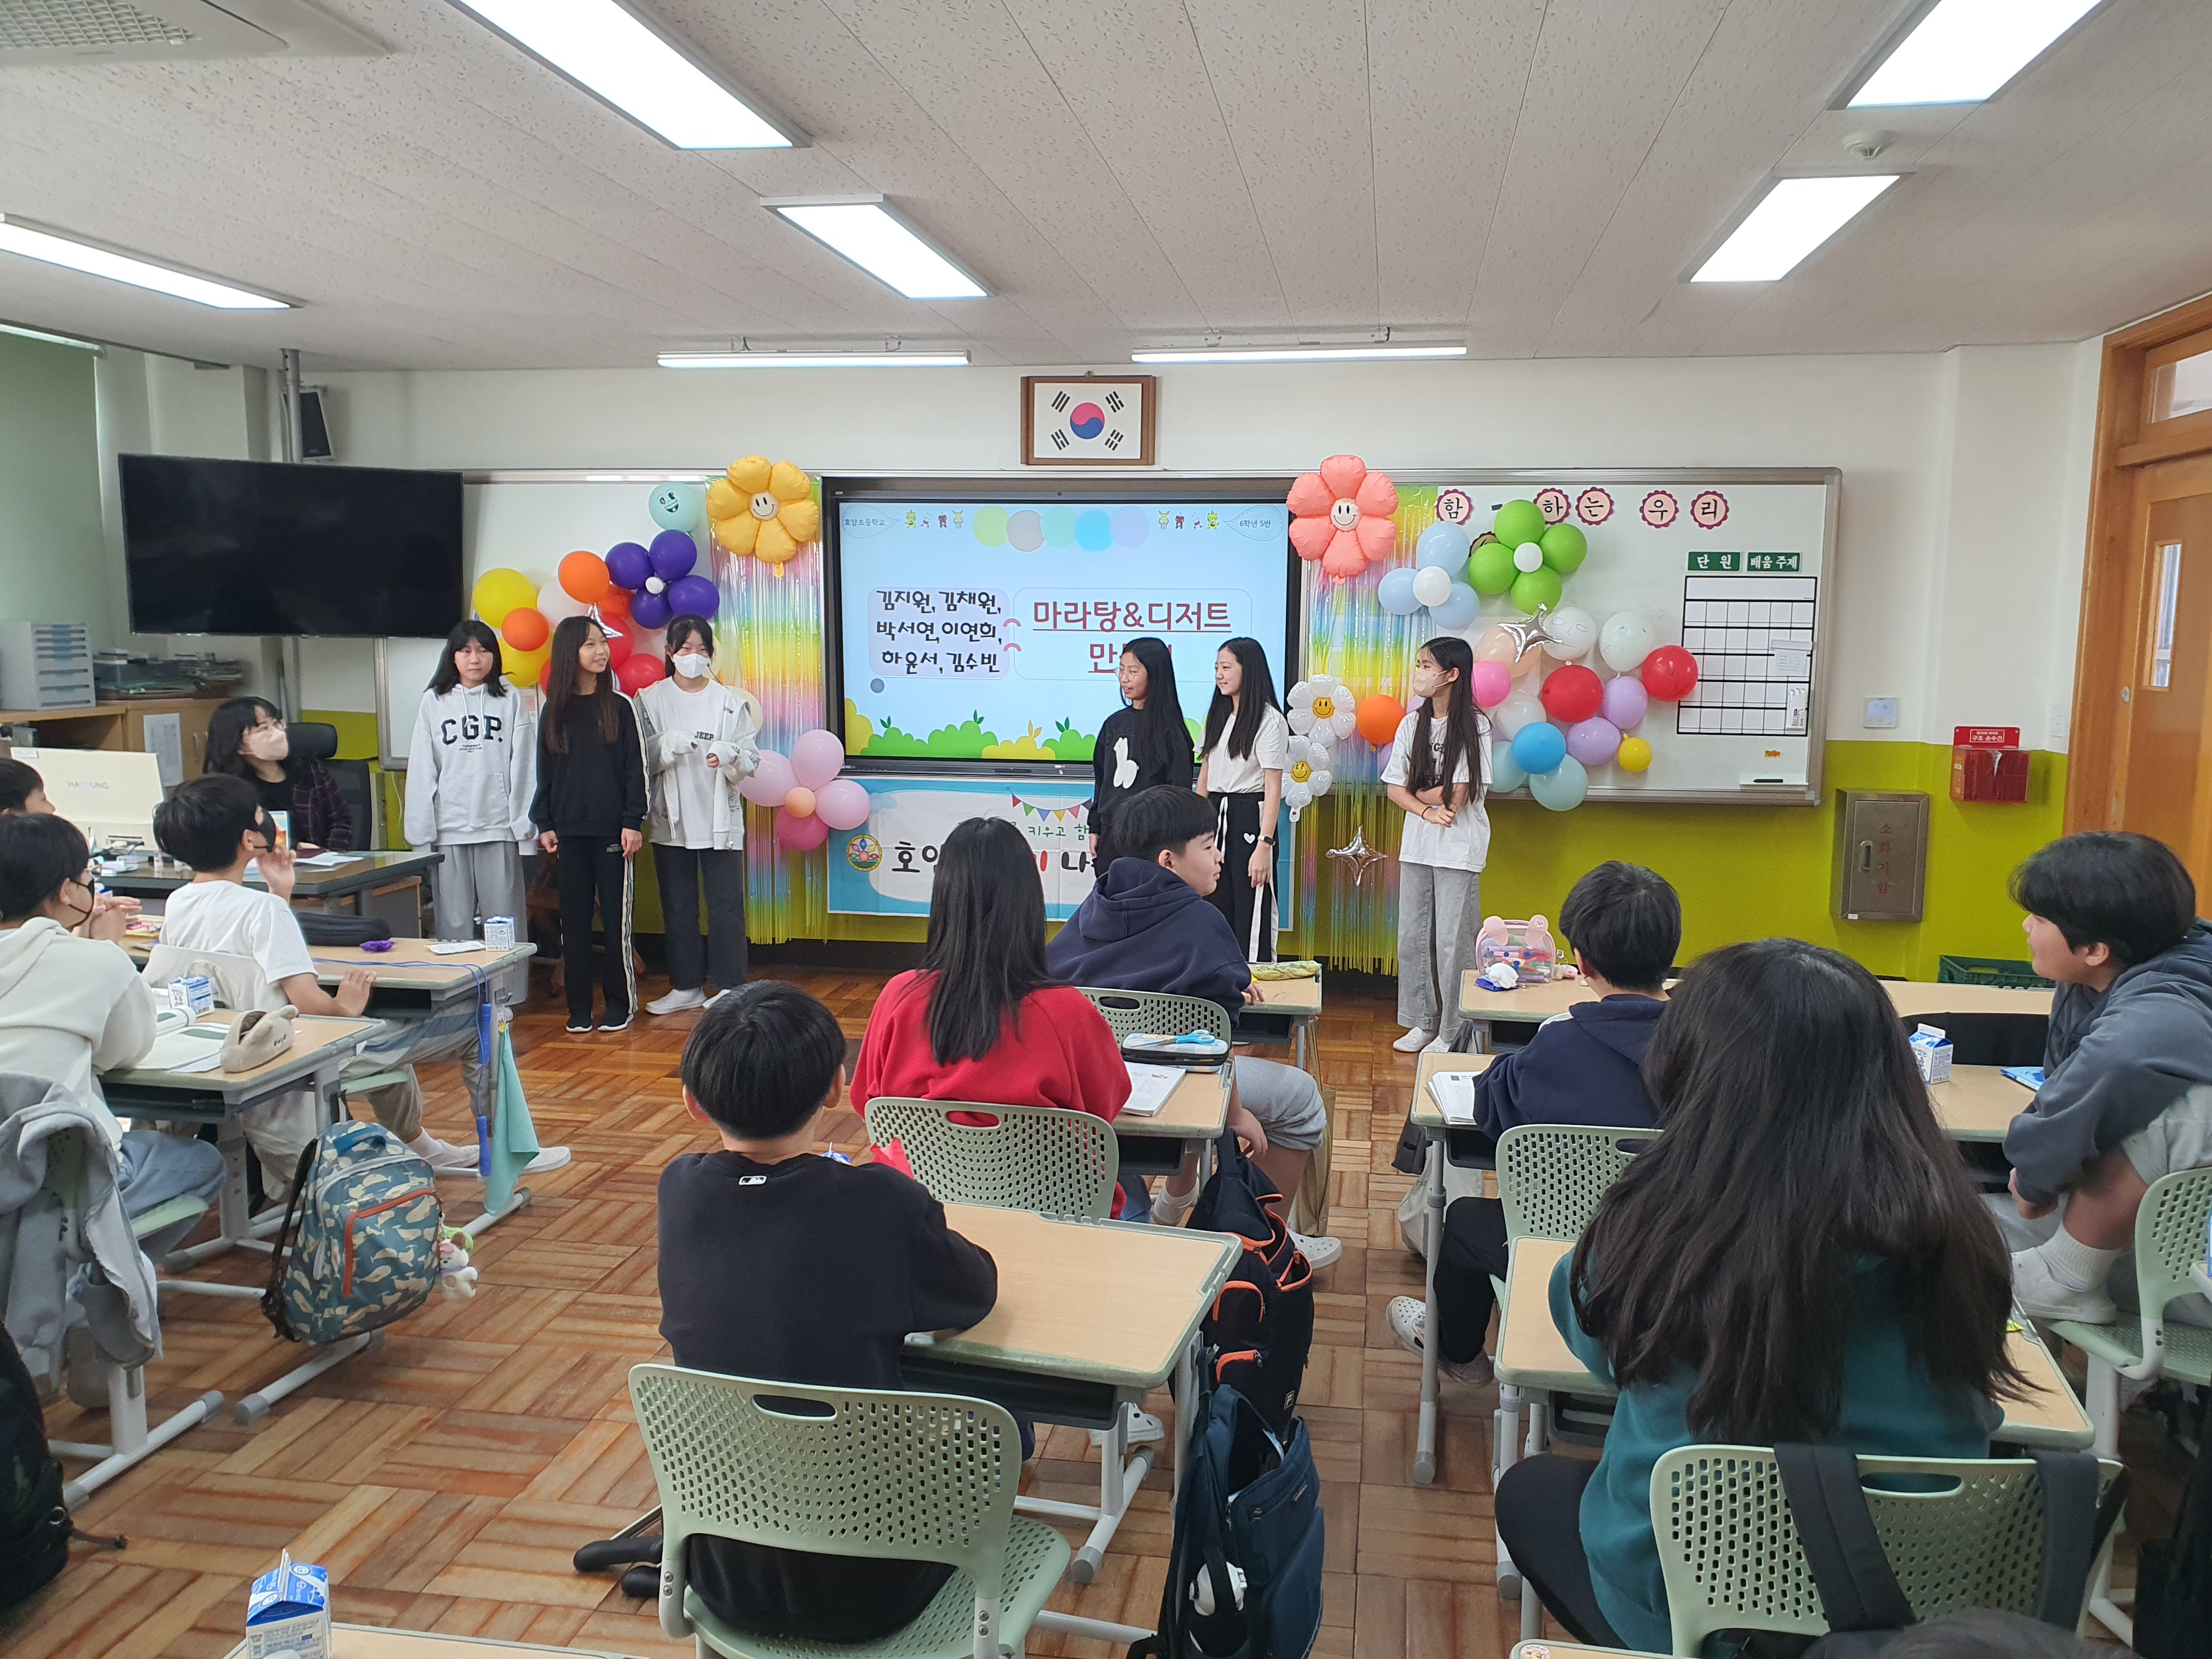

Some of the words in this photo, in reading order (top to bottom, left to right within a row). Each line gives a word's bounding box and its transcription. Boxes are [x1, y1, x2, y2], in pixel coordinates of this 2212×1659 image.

[844, 518, 885, 527] 호암초등학교
[1240, 520, 1257, 528] 6학년
[1260, 520, 1271, 528] 5반
[1750, 555, 1773, 569] 배움
[1775, 555, 1797, 570] 주제
[876, 590, 935, 613] 김지원,
[939, 591, 1001, 614] 김채원,
[1034, 601, 1231, 632] 마라탕&디저트
[877, 620, 940, 644] 박서연,
[941, 622, 1002, 645] 이연희,
[882, 651, 943, 674] 하윤서,
[946, 652, 1000, 673] 김수빈
[67, 781, 109, 789] HAUNG
[1028, 825, 1066, 837] 키우고
